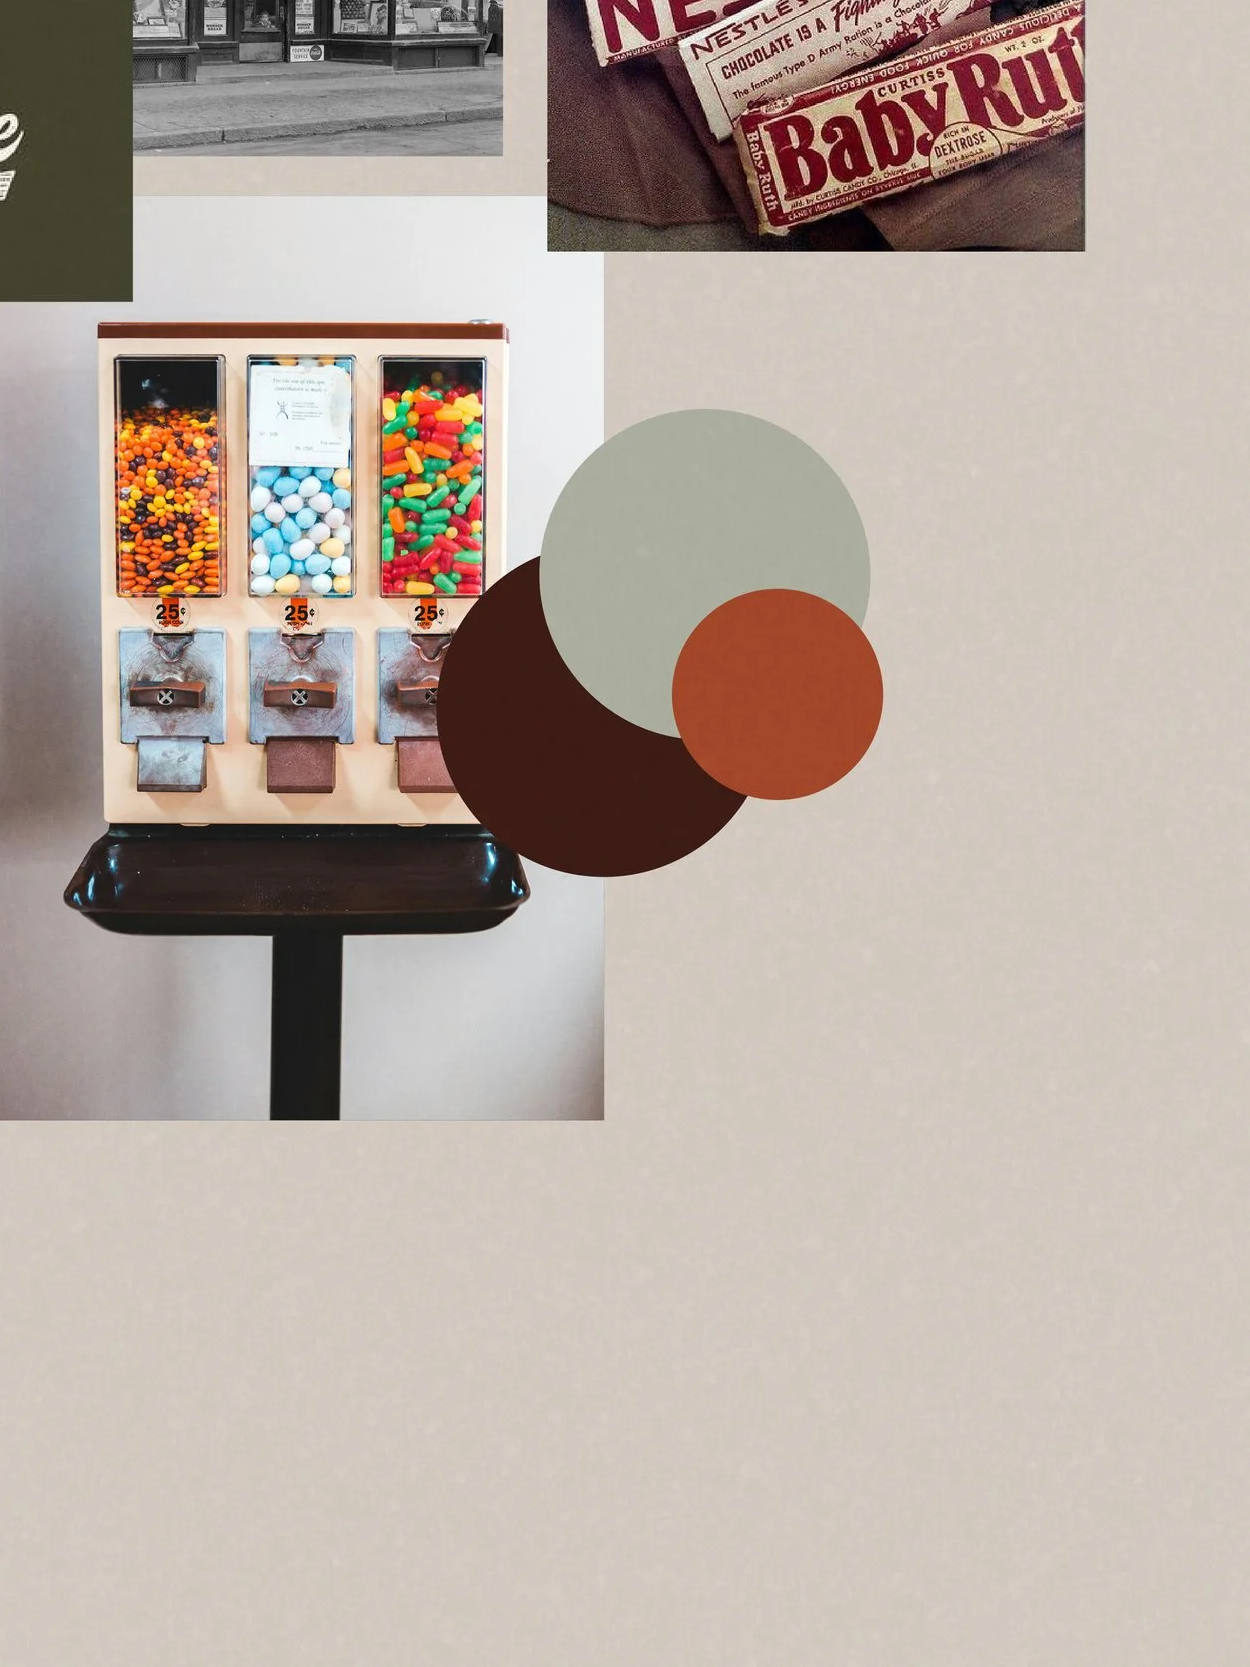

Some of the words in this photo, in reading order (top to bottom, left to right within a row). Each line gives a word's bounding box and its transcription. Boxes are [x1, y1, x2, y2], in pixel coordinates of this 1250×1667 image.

[720, 33, 794, 80] CHOCOLATE
[795, 24, 813, 43] IS
[815, 17, 827, 34] A
[952, 40, 975, 54] FOR
[978, 26, 1015, 46] CANDY
[731, 89, 749, 101] The
[750, 70, 784, 91] famous
[783, 57, 807, 75] Type
[806, 52, 816, 64] D
[818, 39, 843, 59] Army
[843, 25, 873, 45] Ration
[881, 61, 910, 77] FOOD
[914, 47, 949, 67] QUICK
[877, 66, 946, 98] CURTISS
[763, 81, 949, 201] Baby
[945, 25, 1085, 130] Rut
[934, 130, 987, 159] DEXTROSE
[746, 130, 765, 171] Baby
[758, 172, 779, 212] Ruth
